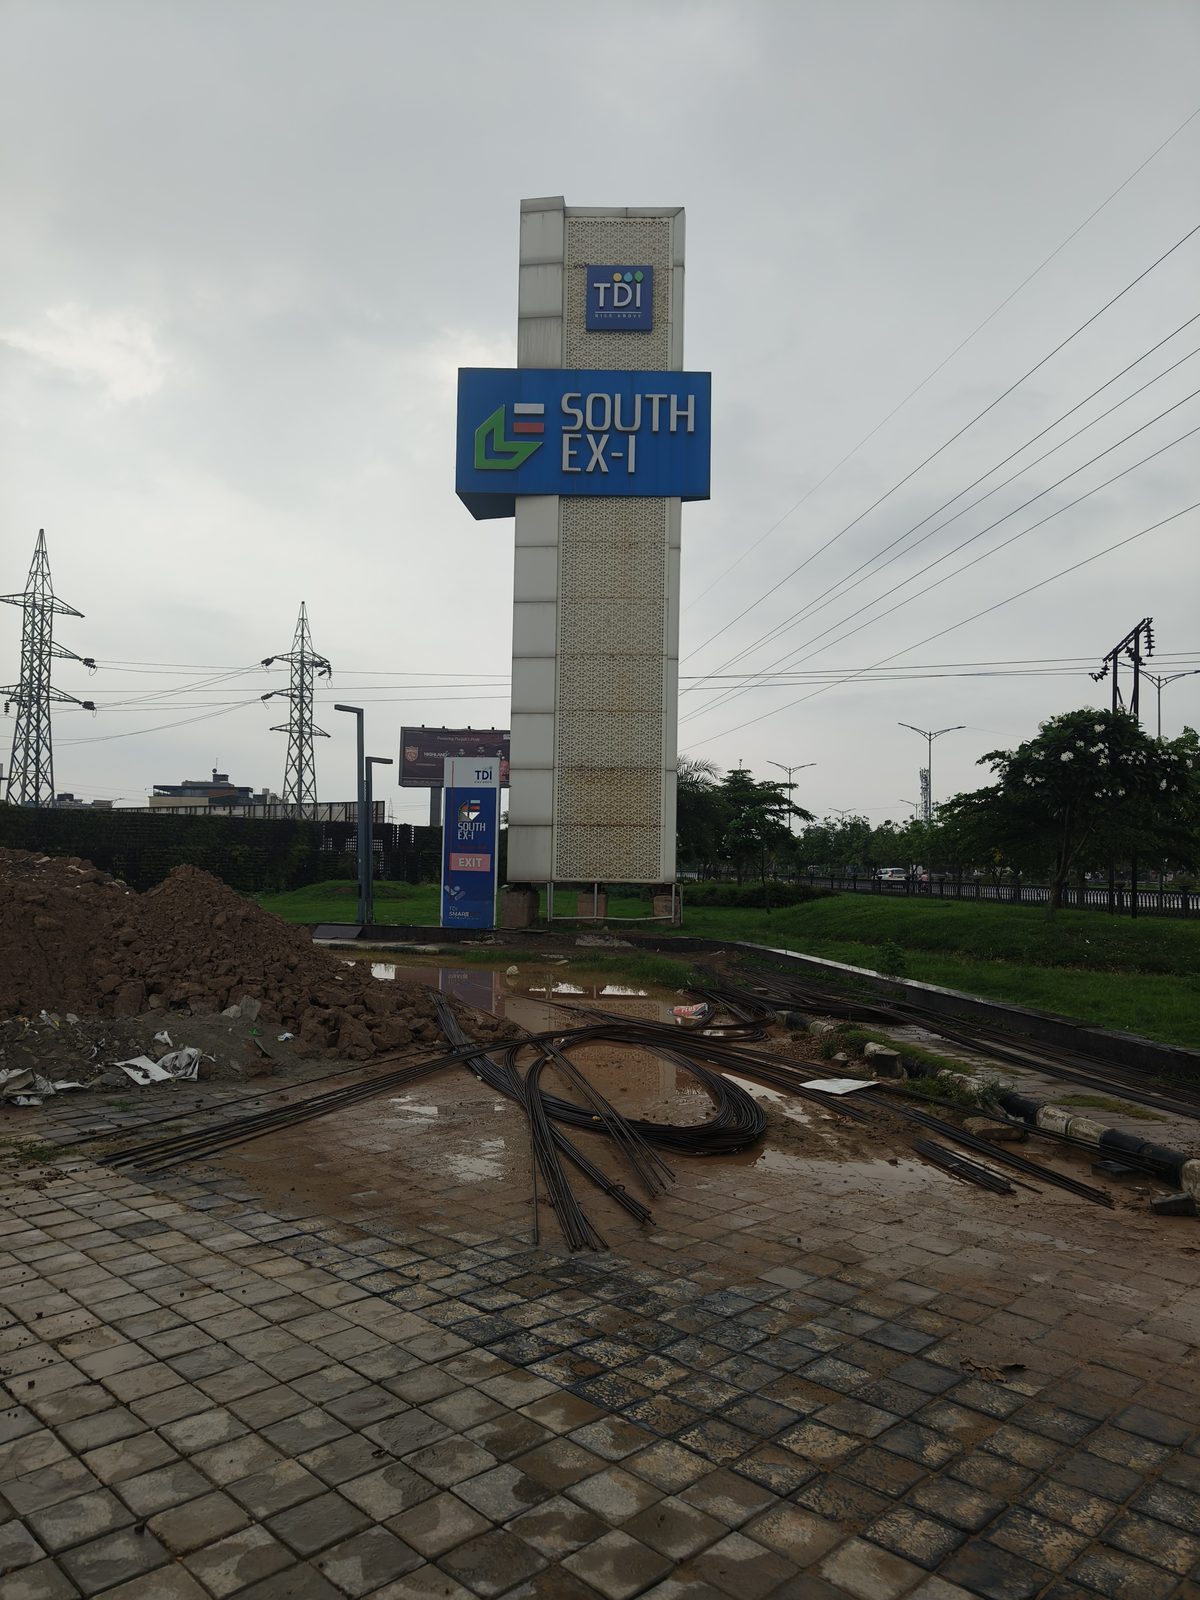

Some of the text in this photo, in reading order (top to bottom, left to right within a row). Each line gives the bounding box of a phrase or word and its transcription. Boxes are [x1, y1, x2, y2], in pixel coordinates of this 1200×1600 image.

[561, 392, 695, 433] SOUTH
[457, 822, 486, 832] SOUTH
[458, 857, 482, 867] EXIT
